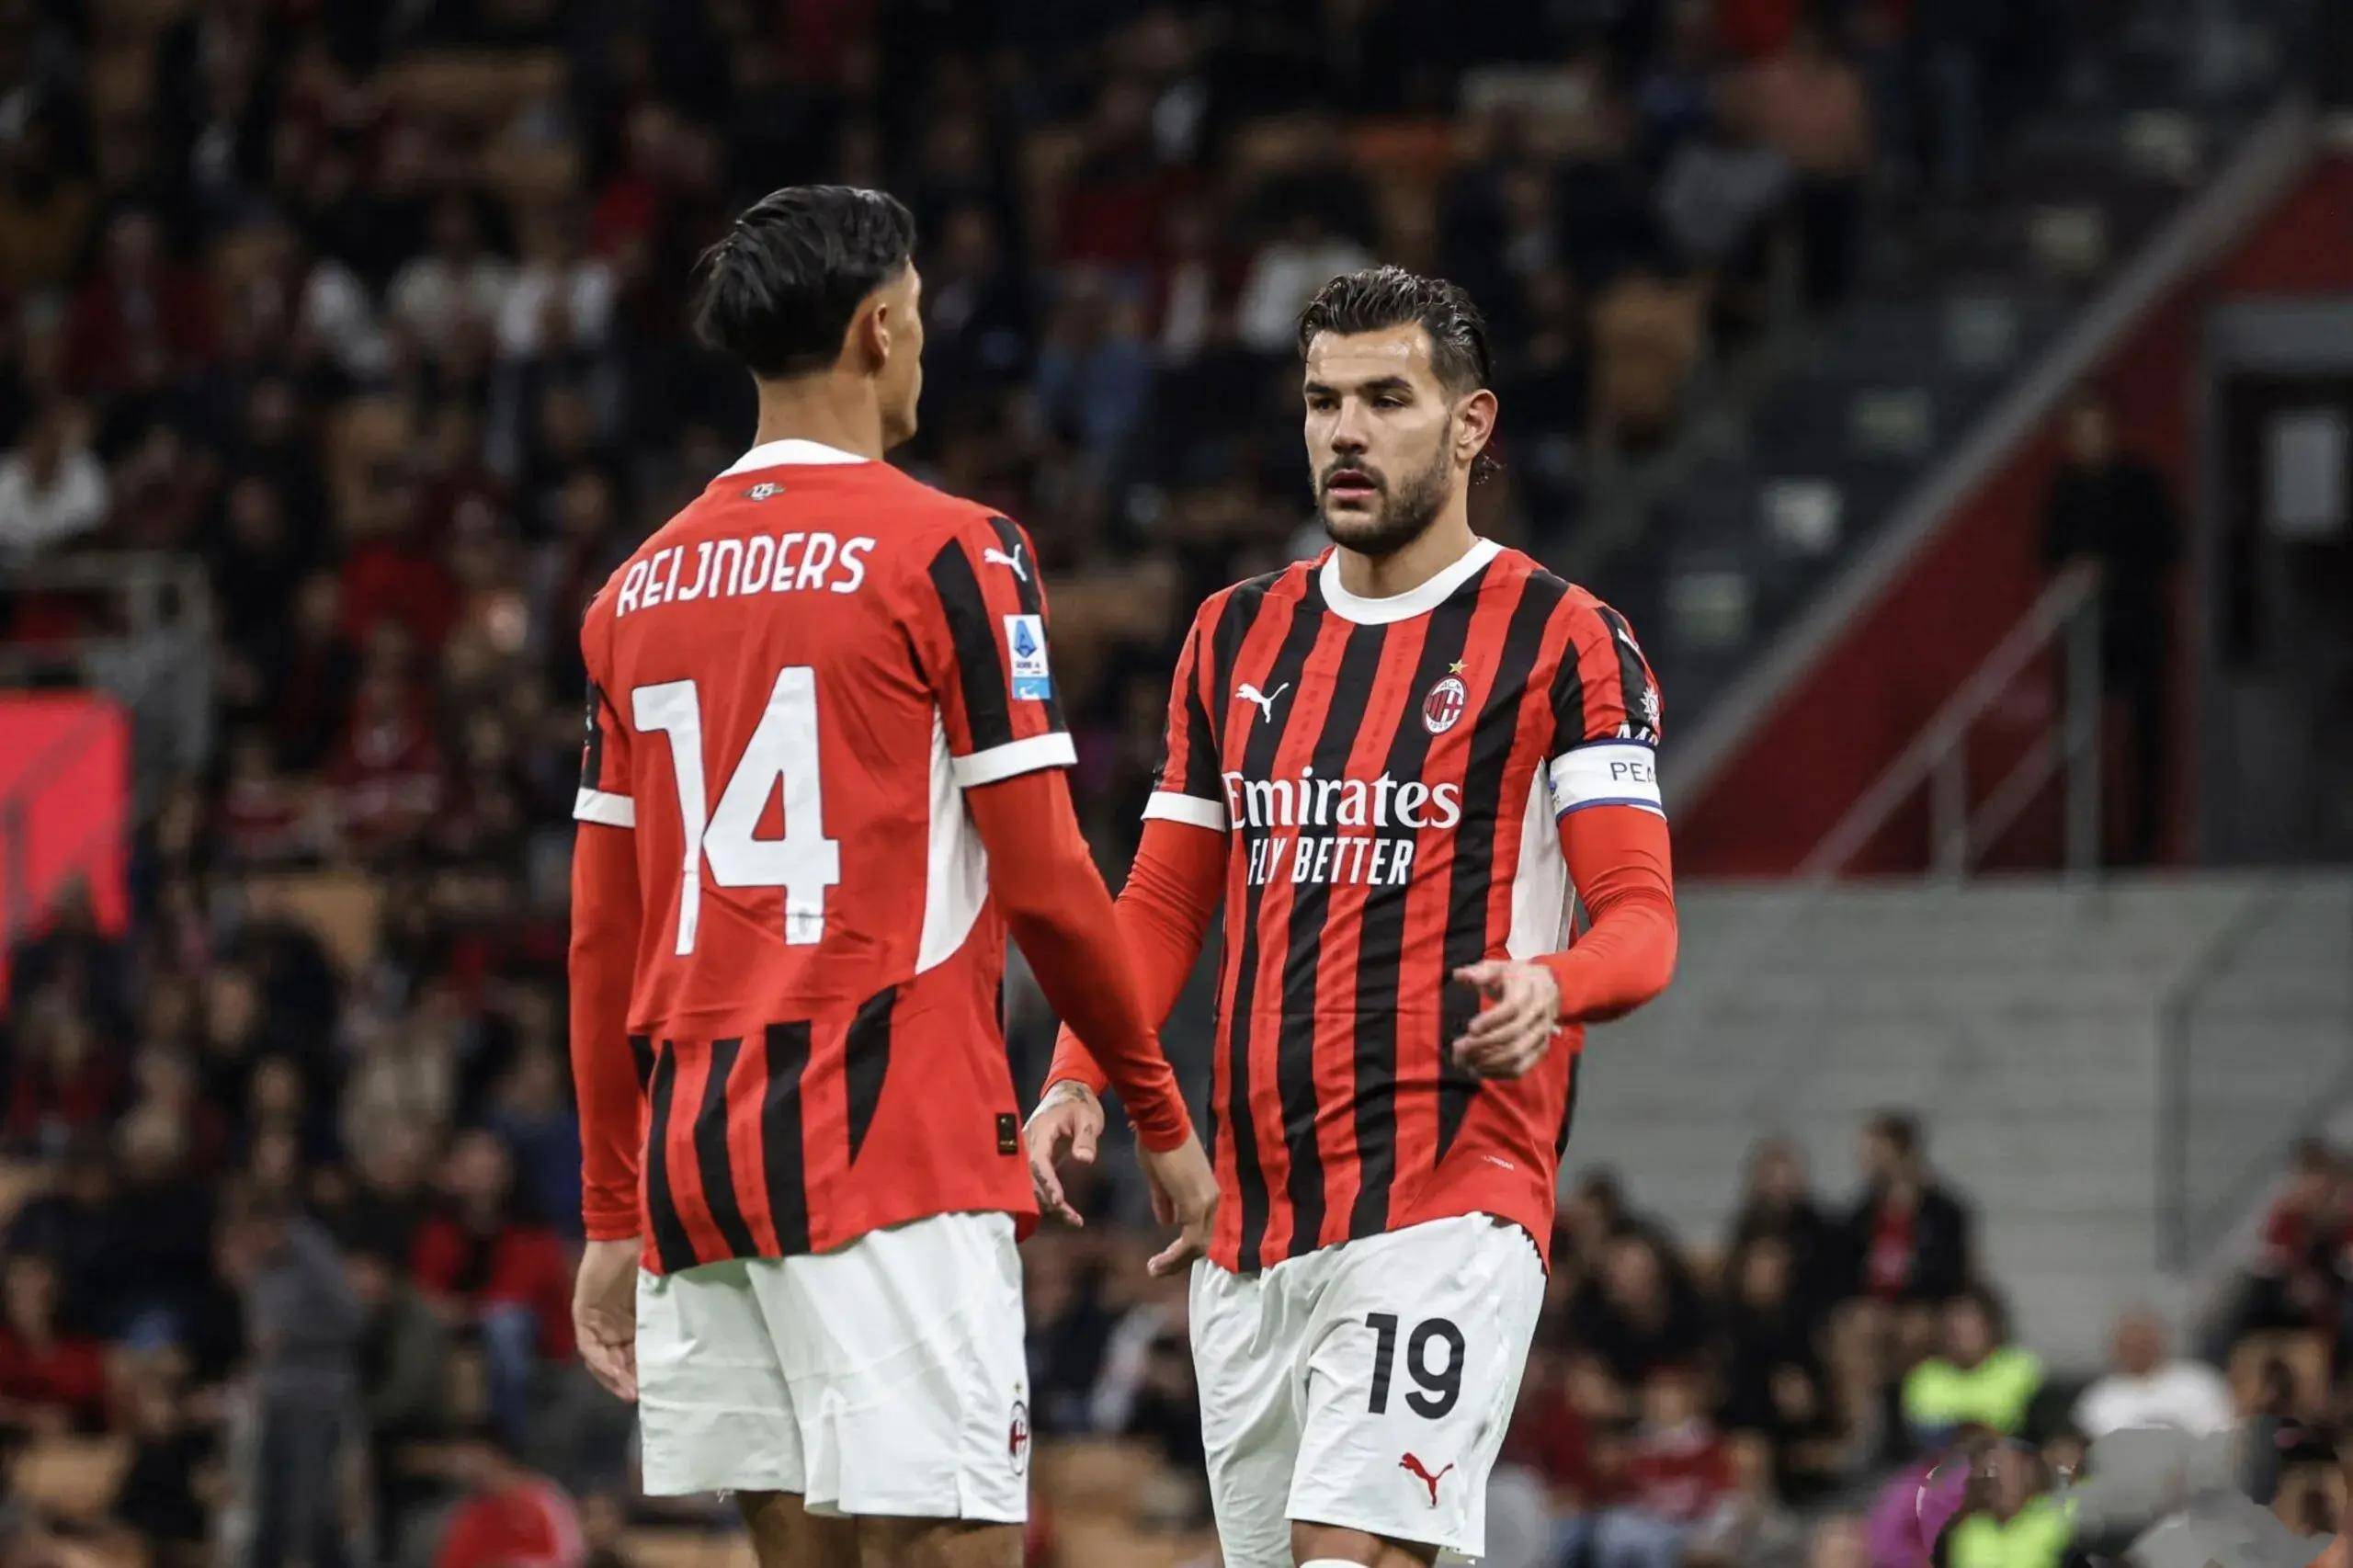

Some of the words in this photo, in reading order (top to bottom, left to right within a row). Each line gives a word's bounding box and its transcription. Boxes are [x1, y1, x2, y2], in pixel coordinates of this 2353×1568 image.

[616, 531, 876, 618] REIJNDERS
[631, 665, 840, 957] 14
[1221, 766, 1461, 830] Emirates
[1247, 836, 1288, 887] FLY
[1290, 836, 1415, 886] BETTER
[1365, 1312, 1465, 1420] 19
